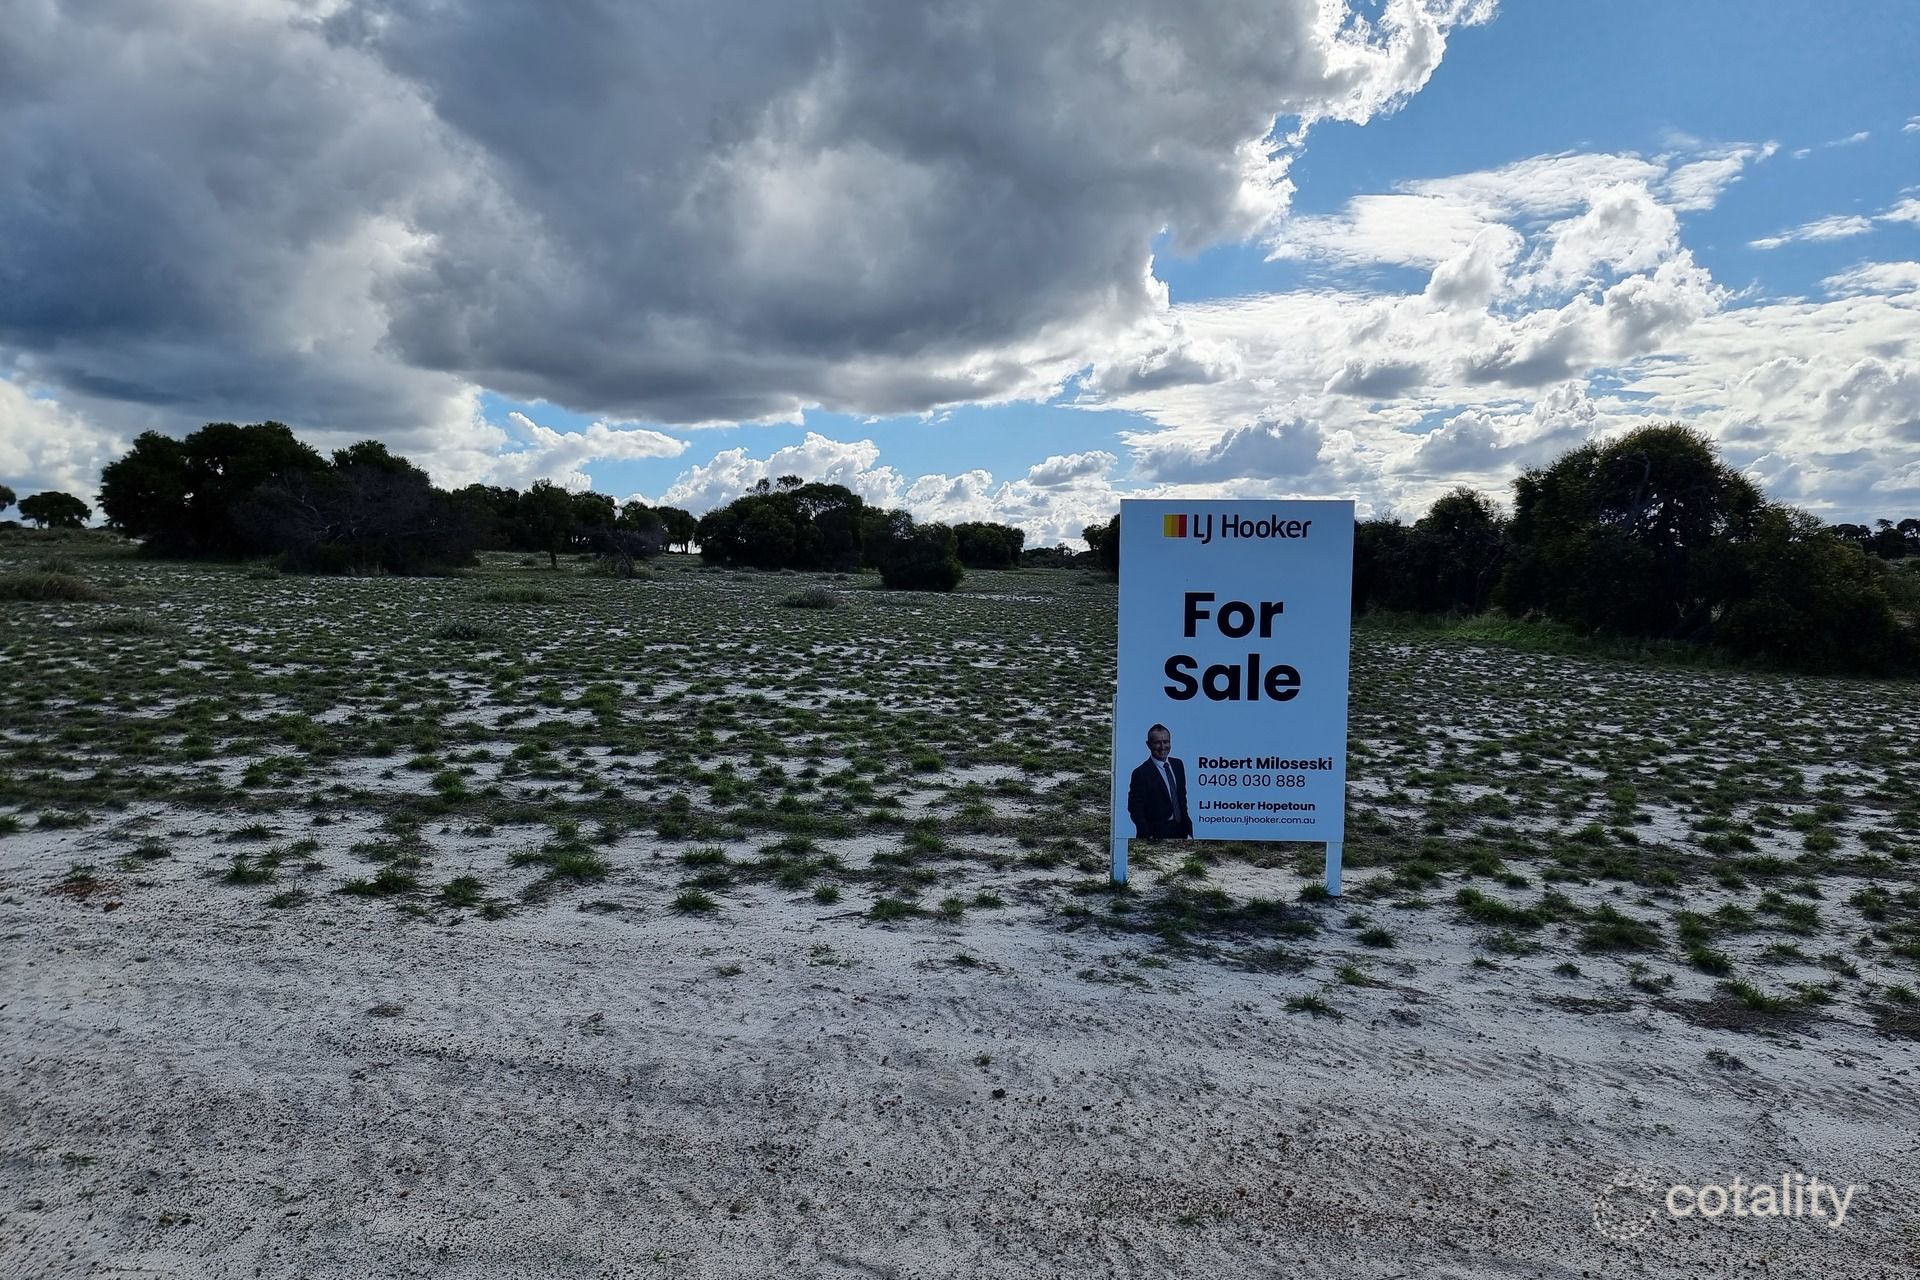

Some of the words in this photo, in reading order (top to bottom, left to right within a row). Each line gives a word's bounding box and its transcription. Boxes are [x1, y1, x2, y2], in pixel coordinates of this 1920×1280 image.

[1193, 513, 1213, 545] LJ
[1221, 513, 1312, 539] Hooker
[1183, 591, 1284, 639] For
[1163, 652, 1302, 702] Sale
[1198, 756, 1253, 769] Robert
[1255, 756, 1333, 770] Miloseski
[1198, 773, 1238, 787] 0408
[1242, 774, 1271, 787] 030
[1275, 774, 1306, 788] 888
[1199, 800, 1211, 810] LJ
[1213, 800, 1256, 811] Hooker
[1257, 801, 1316, 813] Hopetoun
[1198, 815, 1316, 825] hopetoun.ljhooker.com.au
